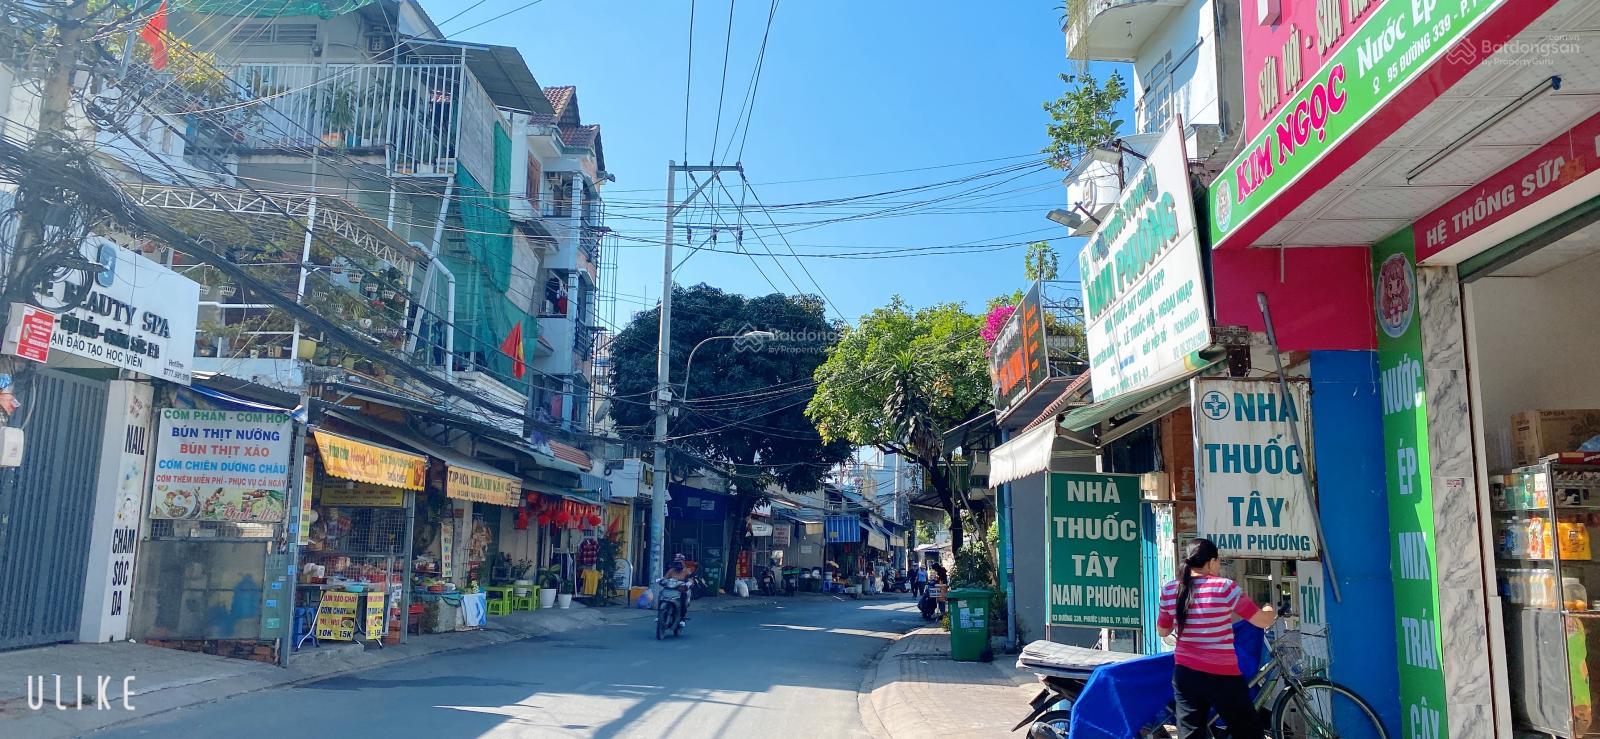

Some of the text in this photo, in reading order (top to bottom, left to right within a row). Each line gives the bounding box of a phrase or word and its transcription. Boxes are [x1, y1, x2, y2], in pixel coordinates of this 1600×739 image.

[1356, 12, 1407, 78] Nước
[1387, 62, 1398, 83] 95
[1399, 32, 1431, 73] ĐƯỜNG
[1432, 14, 1451, 42] 339
[1235, 64, 1345, 204] KIM NGỌC
[1427, 219, 1447, 248] HỆ
[1452, 187, 1515, 233] THỐNG
[1088, 192, 1179, 321] NAM PHƯƠNG
[142, 310, 171, 339] SPA
[67, 335, 85, 351] ĐÀO
[87, 342, 102, 357] TẠO
[106, 348, 122, 363] HỌC
[1382, 353, 1423, 415] NƯỚC
[124, 424, 145, 456] NAIL
[172, 425, 280, 441] BÚN THỊT NƯỚNG
[159, 459, 182, 469] CƠM
[185, 460, 218, 471] CHIÊN
[180, 442, 207, 454] BÚN
[211, 444, 240, 458] THỊT
[1204, 433, 1304, 475] THUỐC
[1397, 438, 1416, 495] ÉP
[1067, 478, 1121, 503] NHÀ
[1228, 490, 1284, 527] TÂY
[1053, 512, 1137, 541] THUỐC
[1206, 534, 1311, 551] NAM PHƯƠNG
[1399, 532, 1430, 580] MIX
[112, 556, 129, 587] SÓC
[1072, 551, 1119, 577] TÂY
[111, 590, 122, 616] DA
[1052, 584, 1139, 609] NAM PHƯƠNG
[1301, 577, 1320, 623] TÂY
[319, 629, 333, 637] 10K
[1402, 608, 1438, 670] TRÁI
